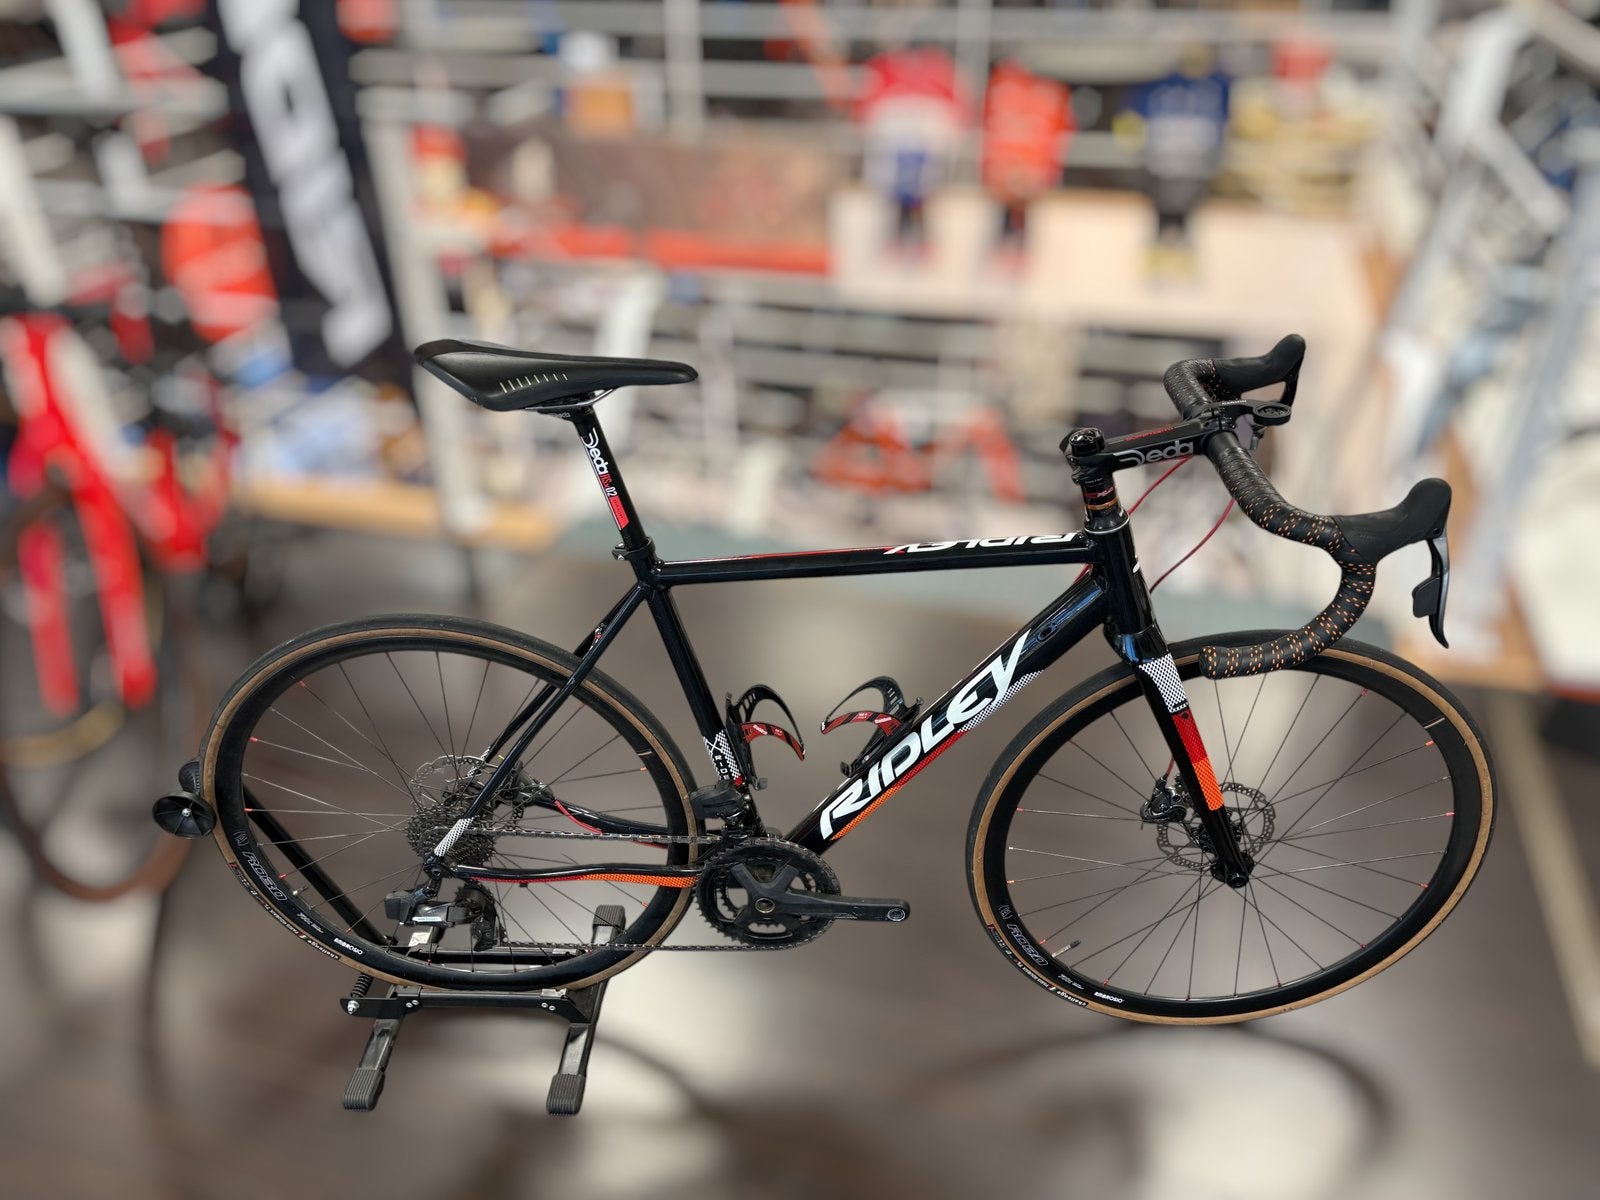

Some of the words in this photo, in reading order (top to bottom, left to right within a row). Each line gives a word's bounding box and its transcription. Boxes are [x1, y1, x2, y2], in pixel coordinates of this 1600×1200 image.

[580, 427, 609, 475] Deda
[1112, 440, 1194, 465] Deda
[819, 628, 1031, 840] RIDLEY
